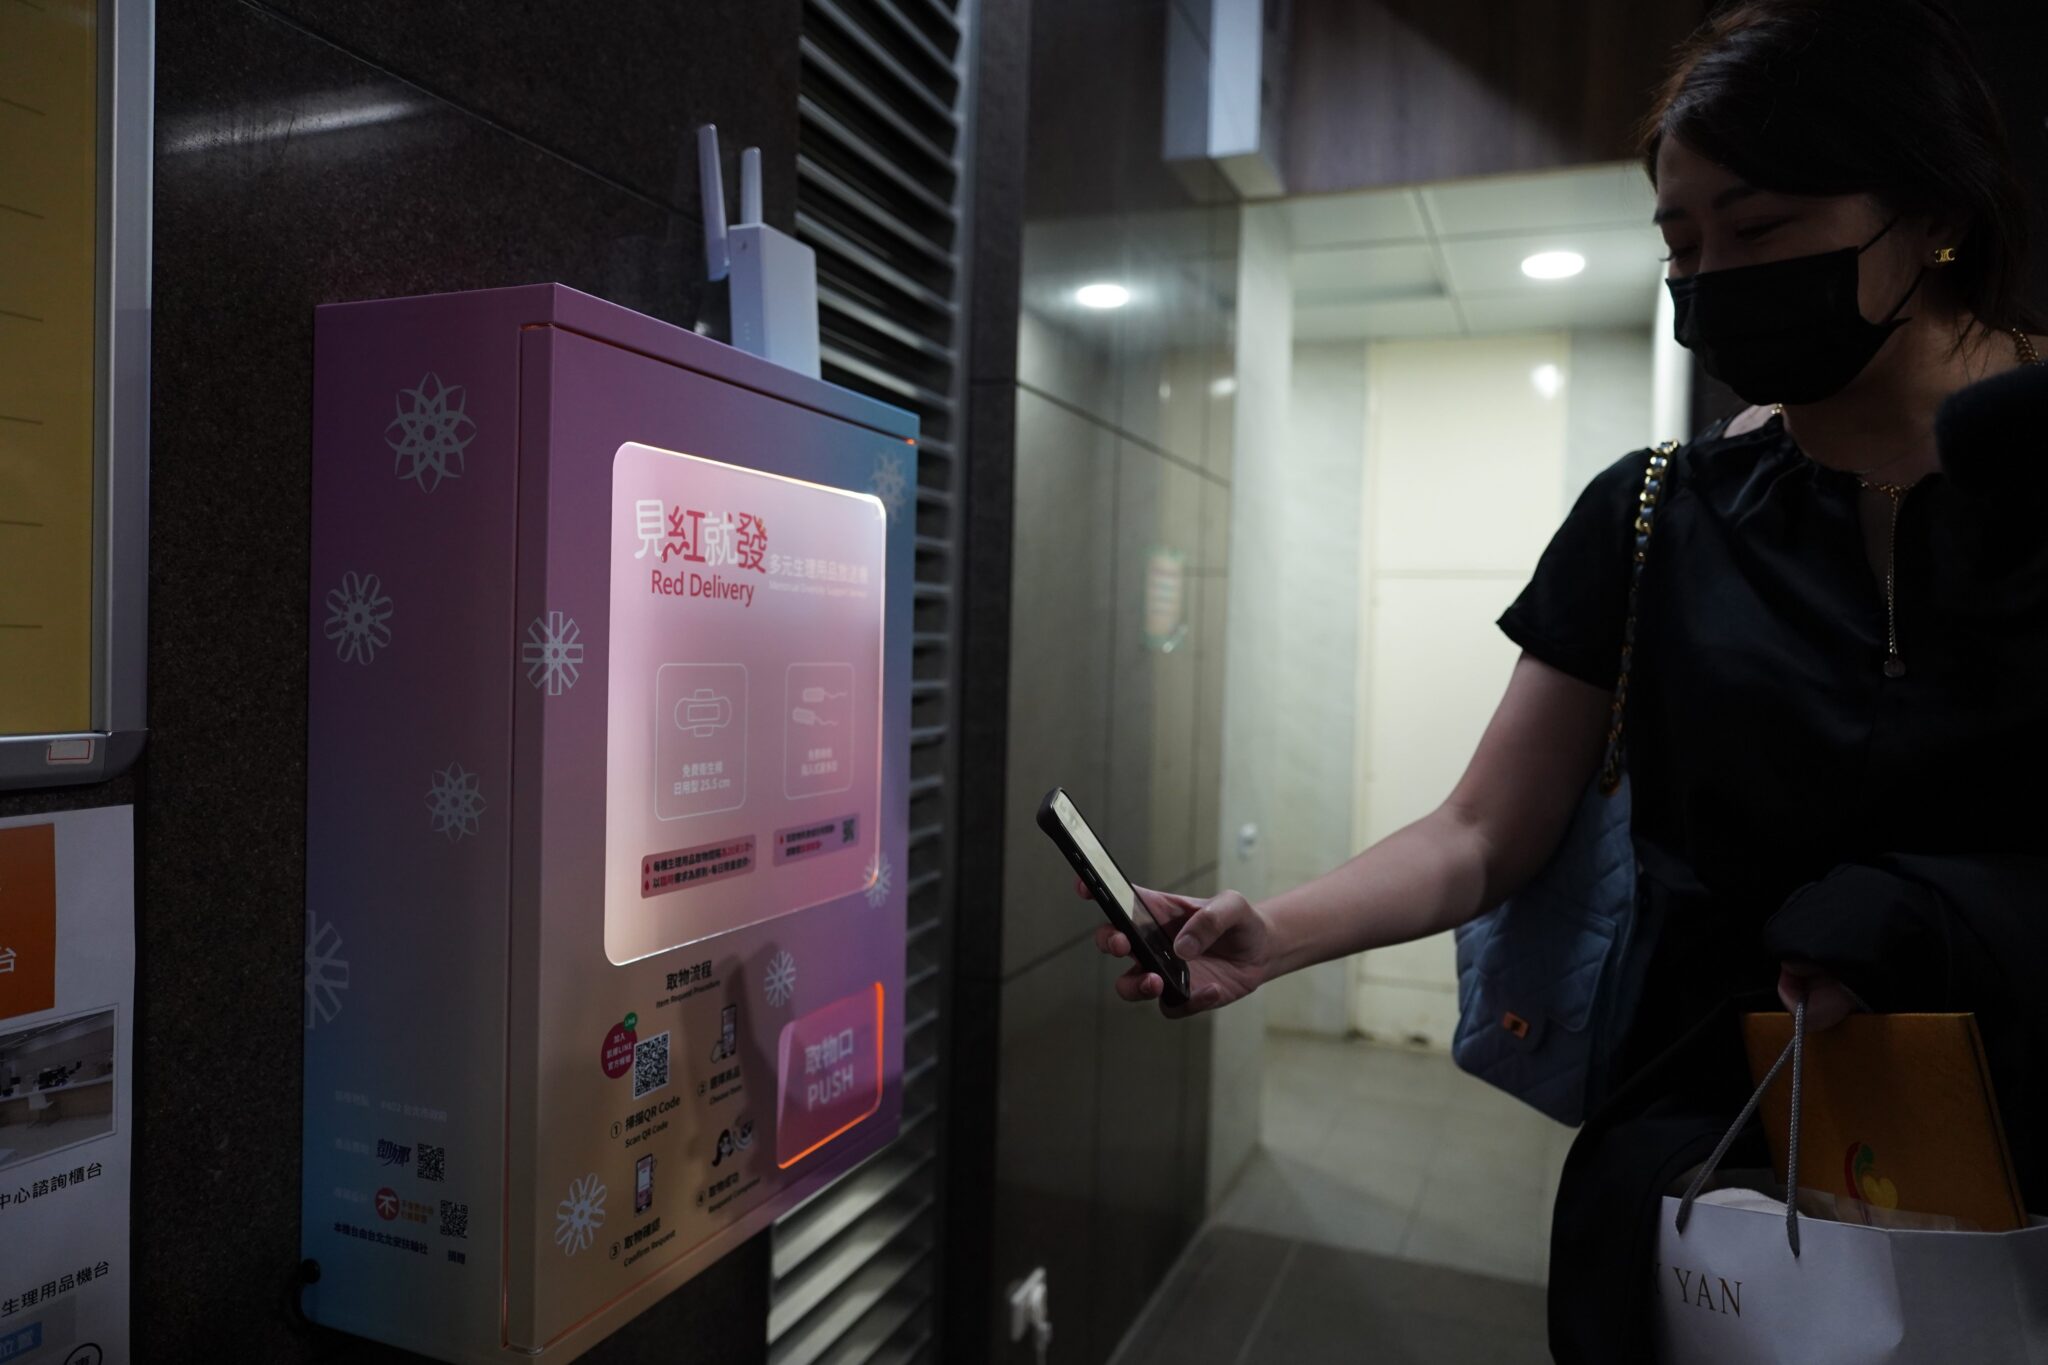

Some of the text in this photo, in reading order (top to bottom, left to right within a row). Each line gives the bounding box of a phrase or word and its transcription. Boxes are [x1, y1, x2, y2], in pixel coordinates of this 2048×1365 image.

[634, 499, 768, 574] 見紅就發
[651, 570, 684, 597] Red
[690, 573, 755, 608] Delivery
[666, 960, 712, 990] 取物流程
[804, 1027, 854, 1075] 取物口
[659, 1096, 680, 1114] Code
[807, 1063, 854, 1112] PUSH
[625, 1120, 669, 1148] Scan QR Code
[1, 1261, 110, 1318] 生理用品機台
[1672, 1266, 1743, 1318] YAN
